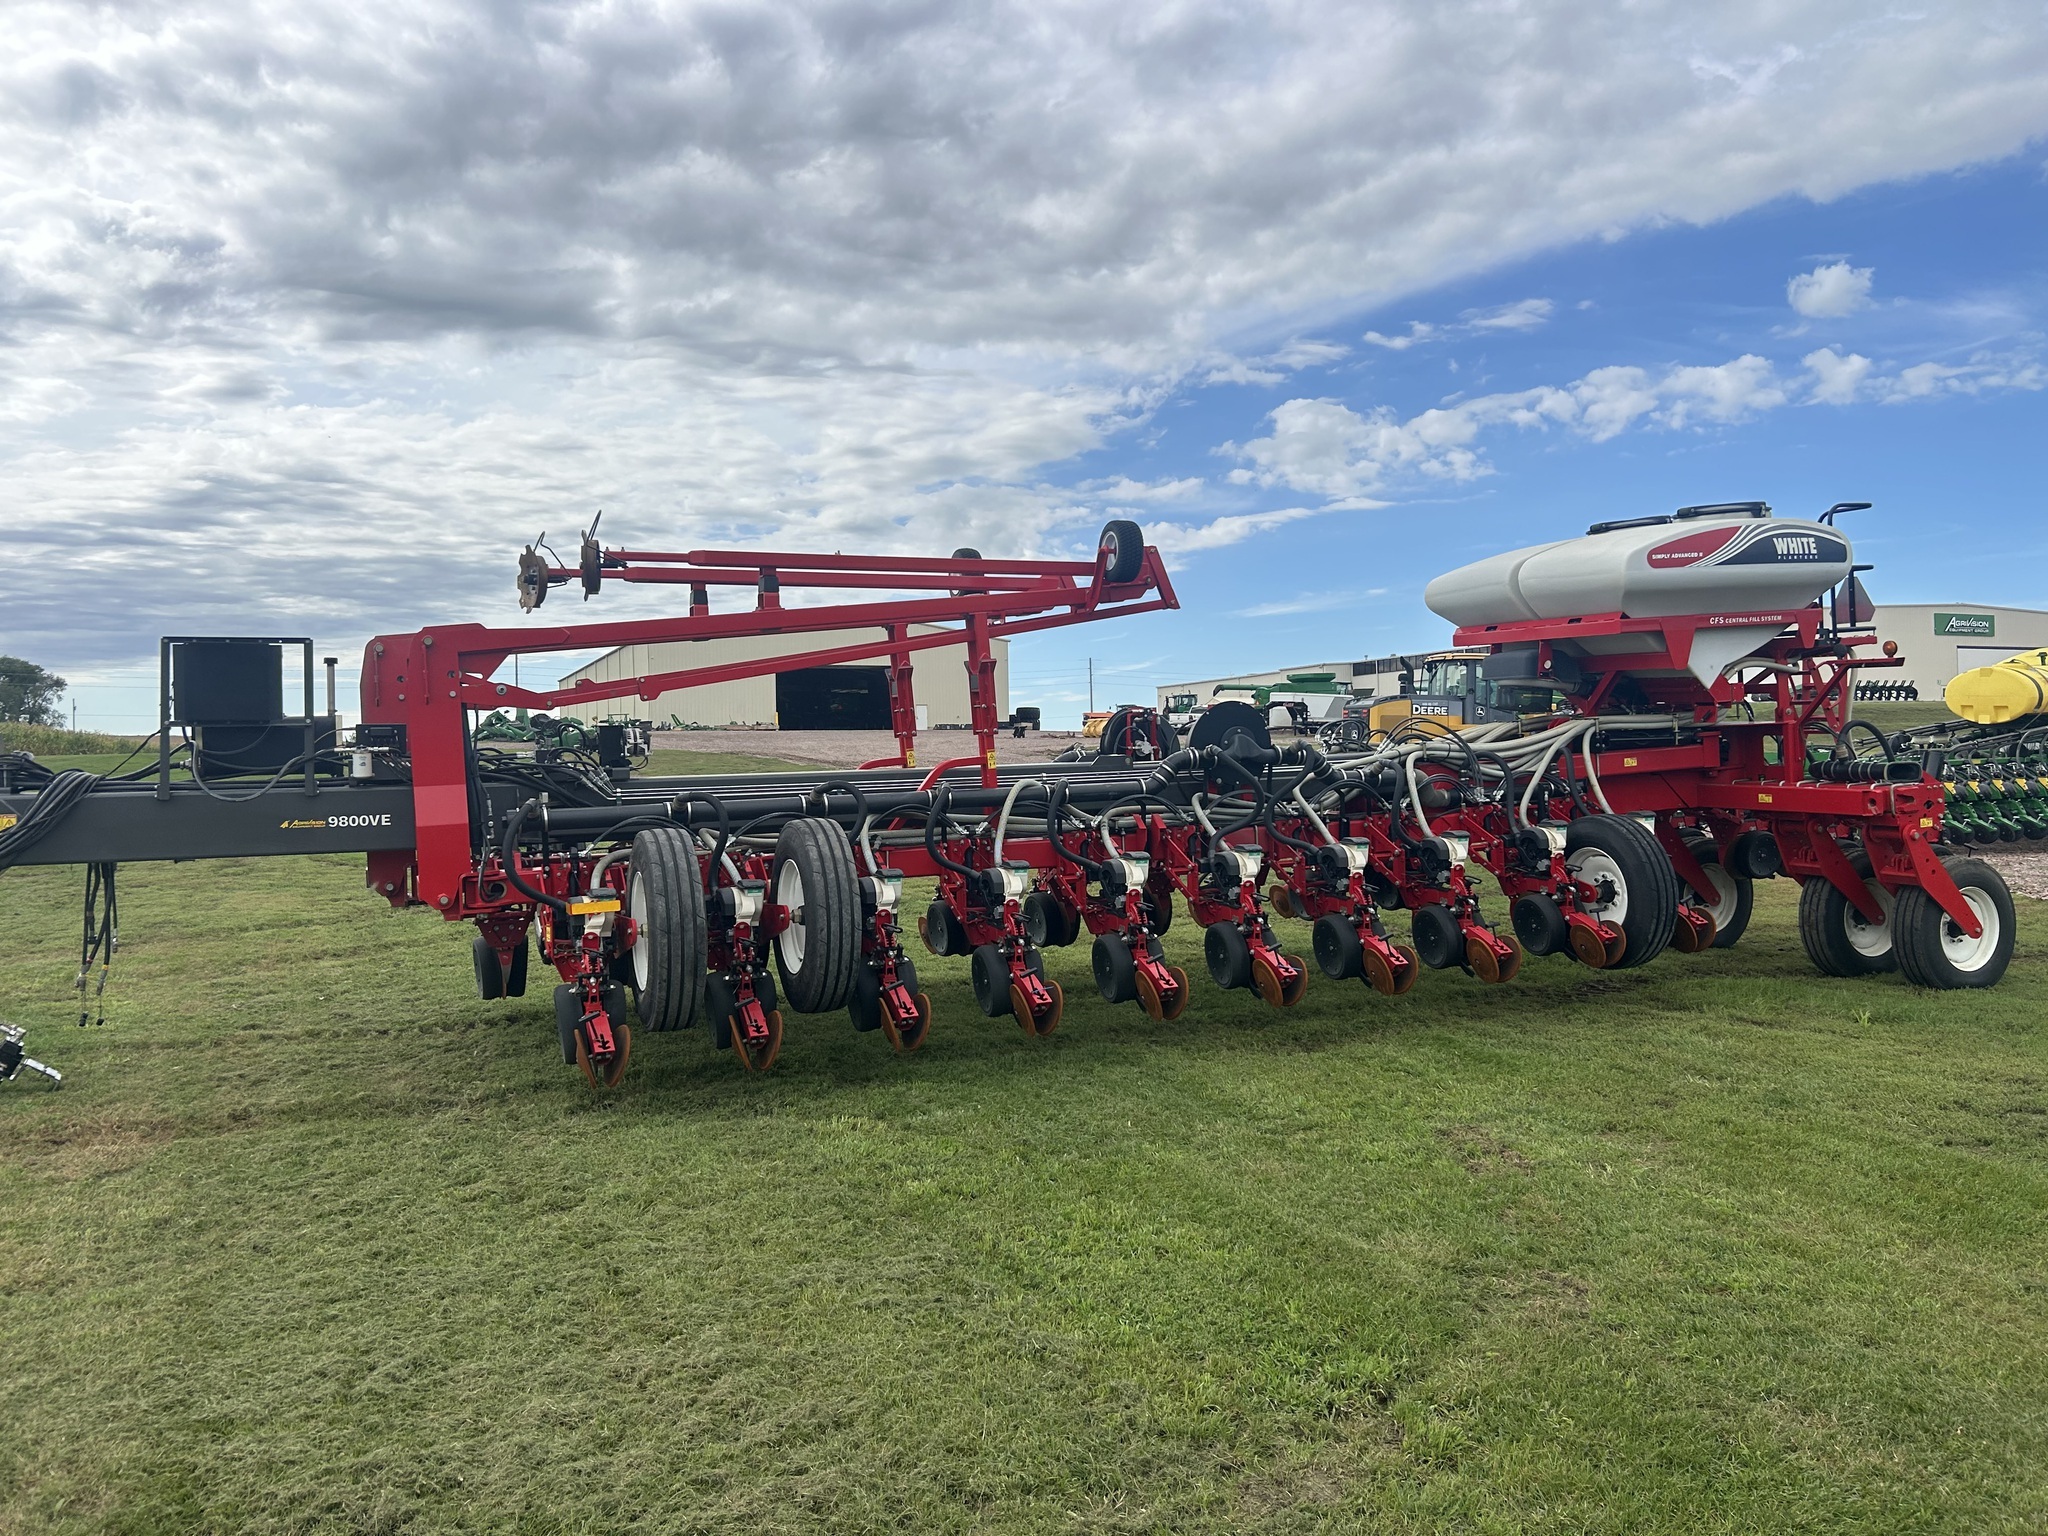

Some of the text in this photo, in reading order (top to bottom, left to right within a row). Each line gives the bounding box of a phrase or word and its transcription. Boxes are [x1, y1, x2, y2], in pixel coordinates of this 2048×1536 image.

[1773, 537, 1817, 554] WHITE
[1709, 616, 1724, 625] CFS
[1412, 704, 1448, 715] DEERE
[328, 814, 391, 828] 9800VE
